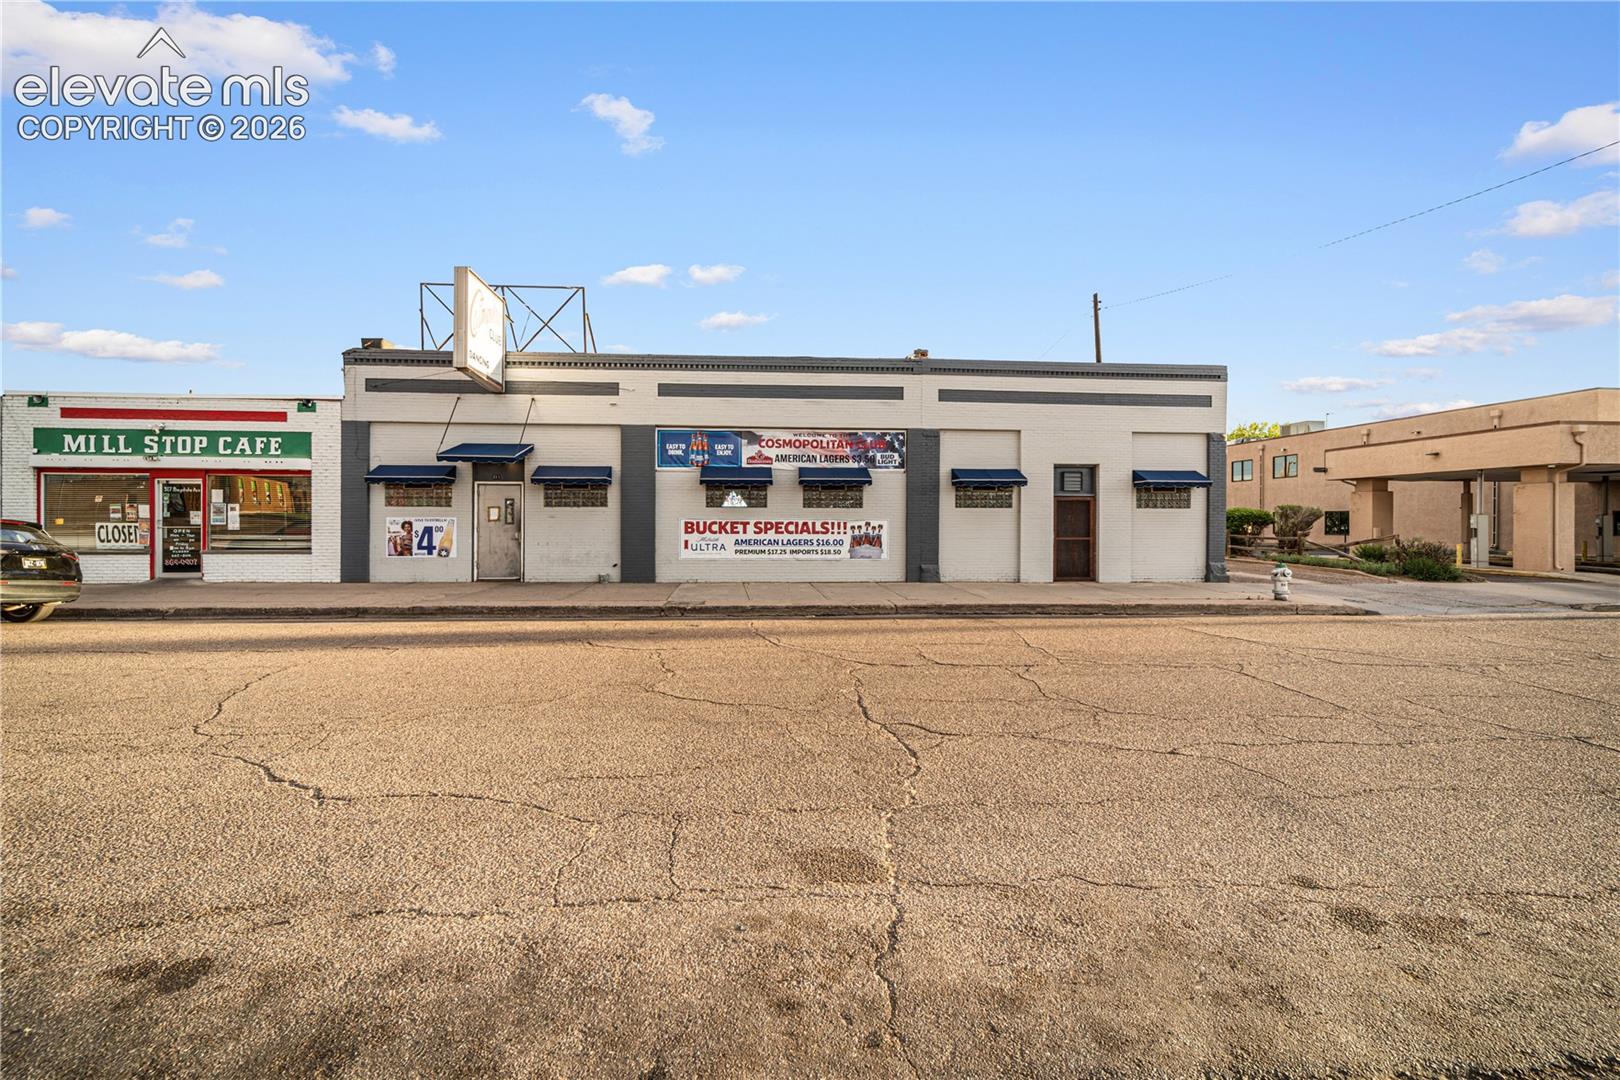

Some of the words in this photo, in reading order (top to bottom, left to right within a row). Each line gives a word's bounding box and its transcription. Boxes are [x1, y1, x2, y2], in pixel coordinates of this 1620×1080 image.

[63, 434, 132, 453] MILL
[144, 436, 208, 454] STOP
[218, 436, 282, 455] CAFE
[758, 438, 854, 449] COSMOPOLITAN
[774, 454, 818, 463] AMERICAN
[819, 454, 850, 464] LAGERS
[684, 521, 750, 534] BUCKET
[753, 521, 848, 535] SPECIALS!!!
[690, 543, 727, 551] ULTRA
[734, 538, 780, 546] AMERICAN
[781, 538, 814, 546] LAGERS
[816, 538, 844, 546] $16.00
